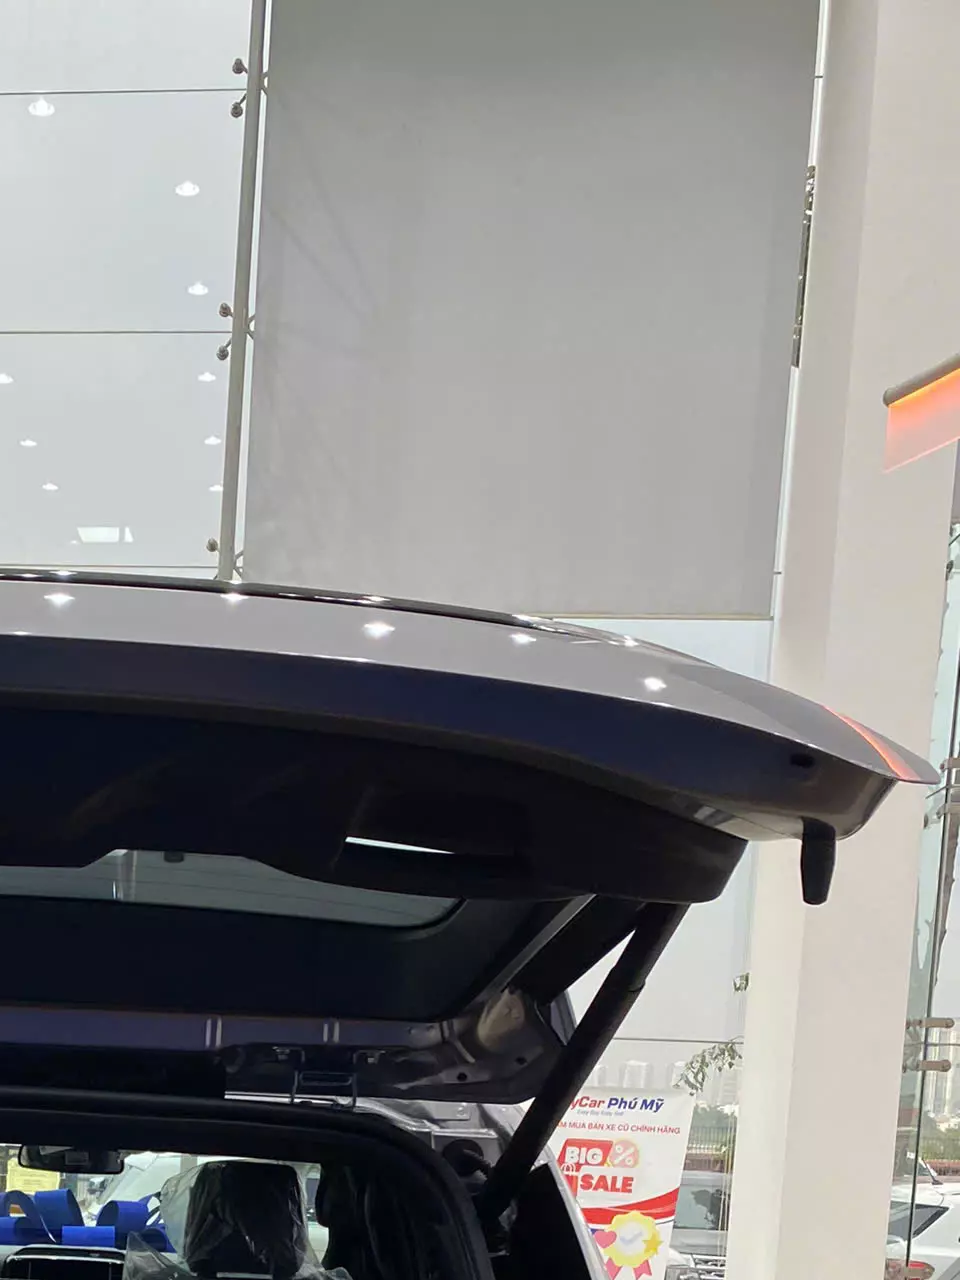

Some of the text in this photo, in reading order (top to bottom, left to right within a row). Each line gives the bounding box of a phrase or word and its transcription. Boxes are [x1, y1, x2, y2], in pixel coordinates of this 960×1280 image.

[607, 1097, 639, 1110] Phú
[639, 1098, 665, 1113] Mỹ
[568, 1122, 587, 1130] MUA
[588, 1121, 605, 1131] BÁN
[618, 1122, 630, 1132] CŨ
[631, 1124, 656, 1133] CHÍNH
[565, 1147, 603, 1164] BIG
[580, 1173, 634, 1193] SALE
